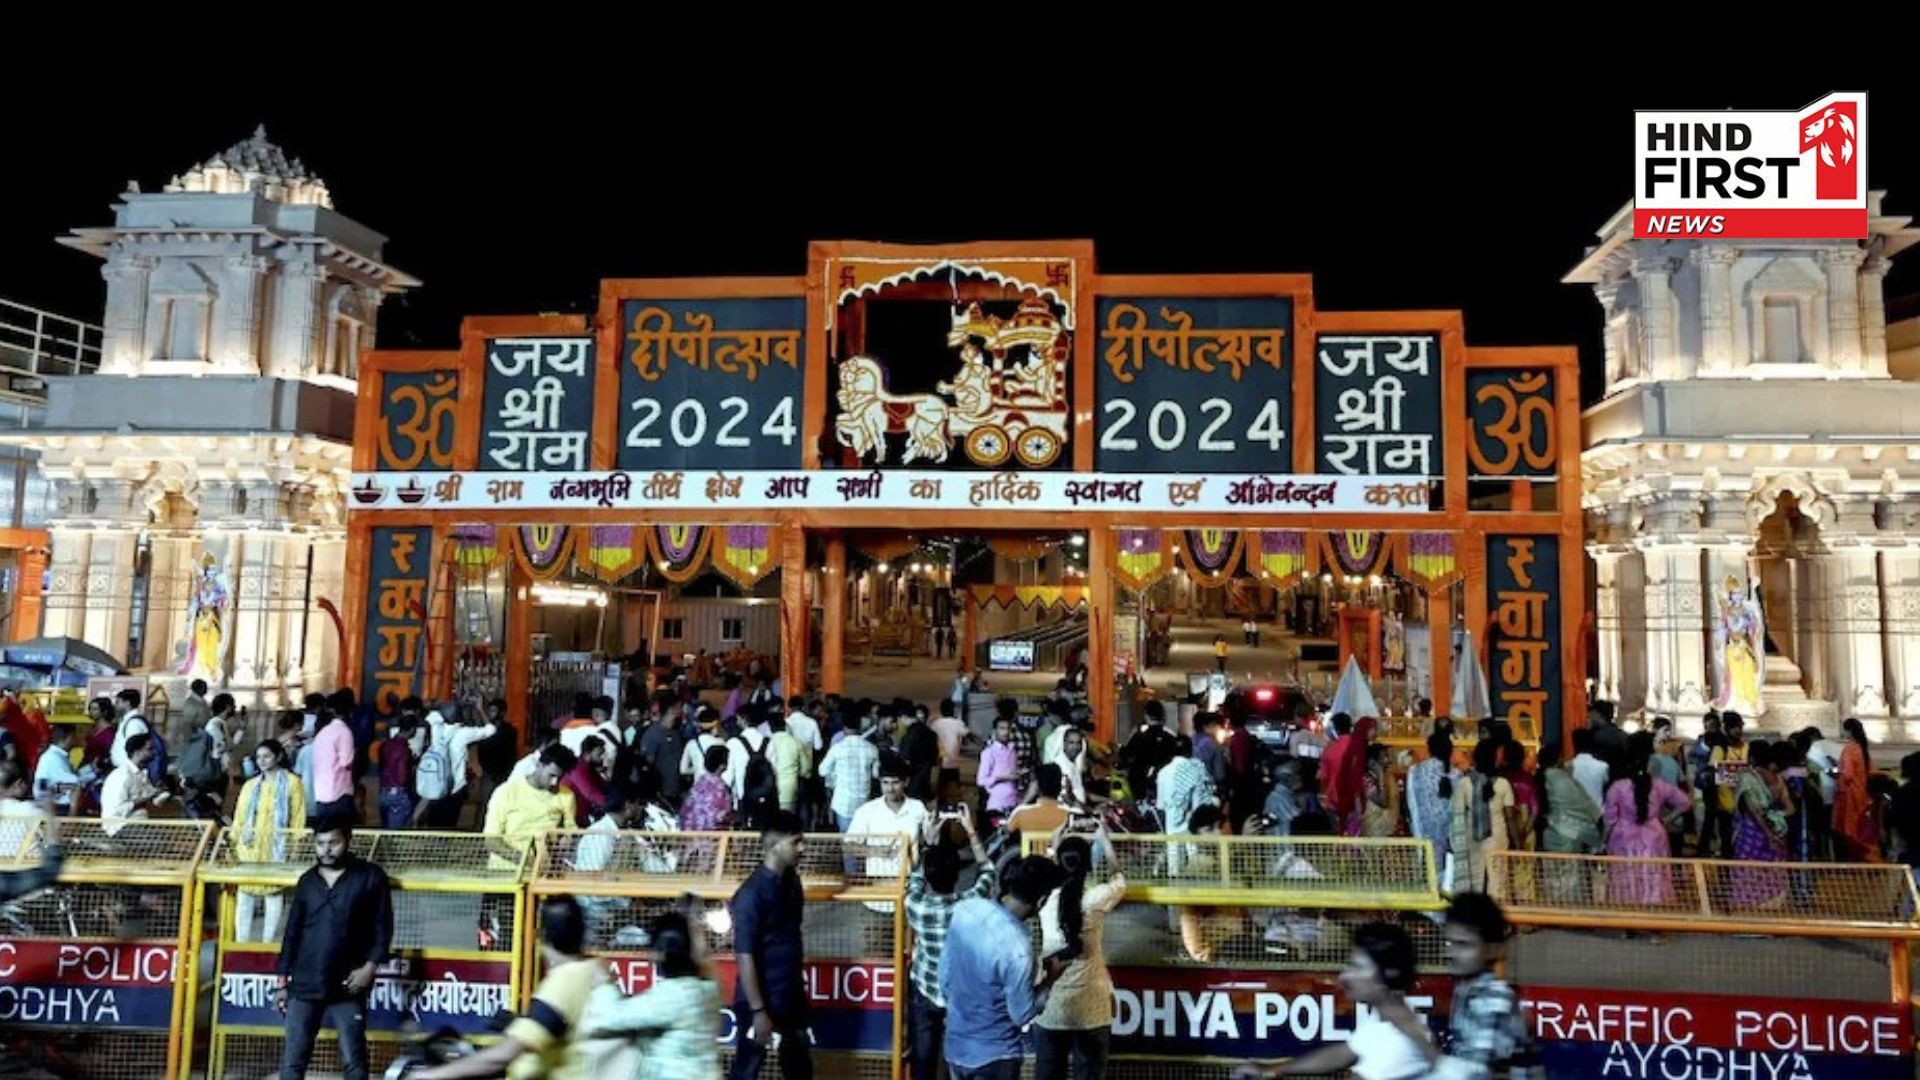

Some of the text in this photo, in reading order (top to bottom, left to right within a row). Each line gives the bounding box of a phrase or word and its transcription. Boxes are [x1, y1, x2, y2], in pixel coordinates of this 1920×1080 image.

[490, 338, 592, 377] जय
[1319, 336, 1433, 376] जय
[499, 376, 566, 429] श्री
[626, 396, 797, 447] 2024
[1335, 375, 1406, 431] श्री
[1100, 398, 1285, 450] 2024
[488, 431, 588, 471] राम
[1323, 434, 1432, 475] राम
[434, 474, 463, 502] श्री
[486, 479, 524, 503] राम
[549, 473, 631, 507] जन्मभूमि
[642, 470, 683, 500] तीर्थ
[765, 475, 810, 500] आप
[836, 471, 883, 502] सभी
[909, 477, 942, 500] का
[969, 473, 1042, 506] हार्दिक
[1064, 479, 1143, 505] स्वागत
[1735, 1010, 1900, 1055] POLICE
[1603, 1041, 1813, 1080] AYODHYA
